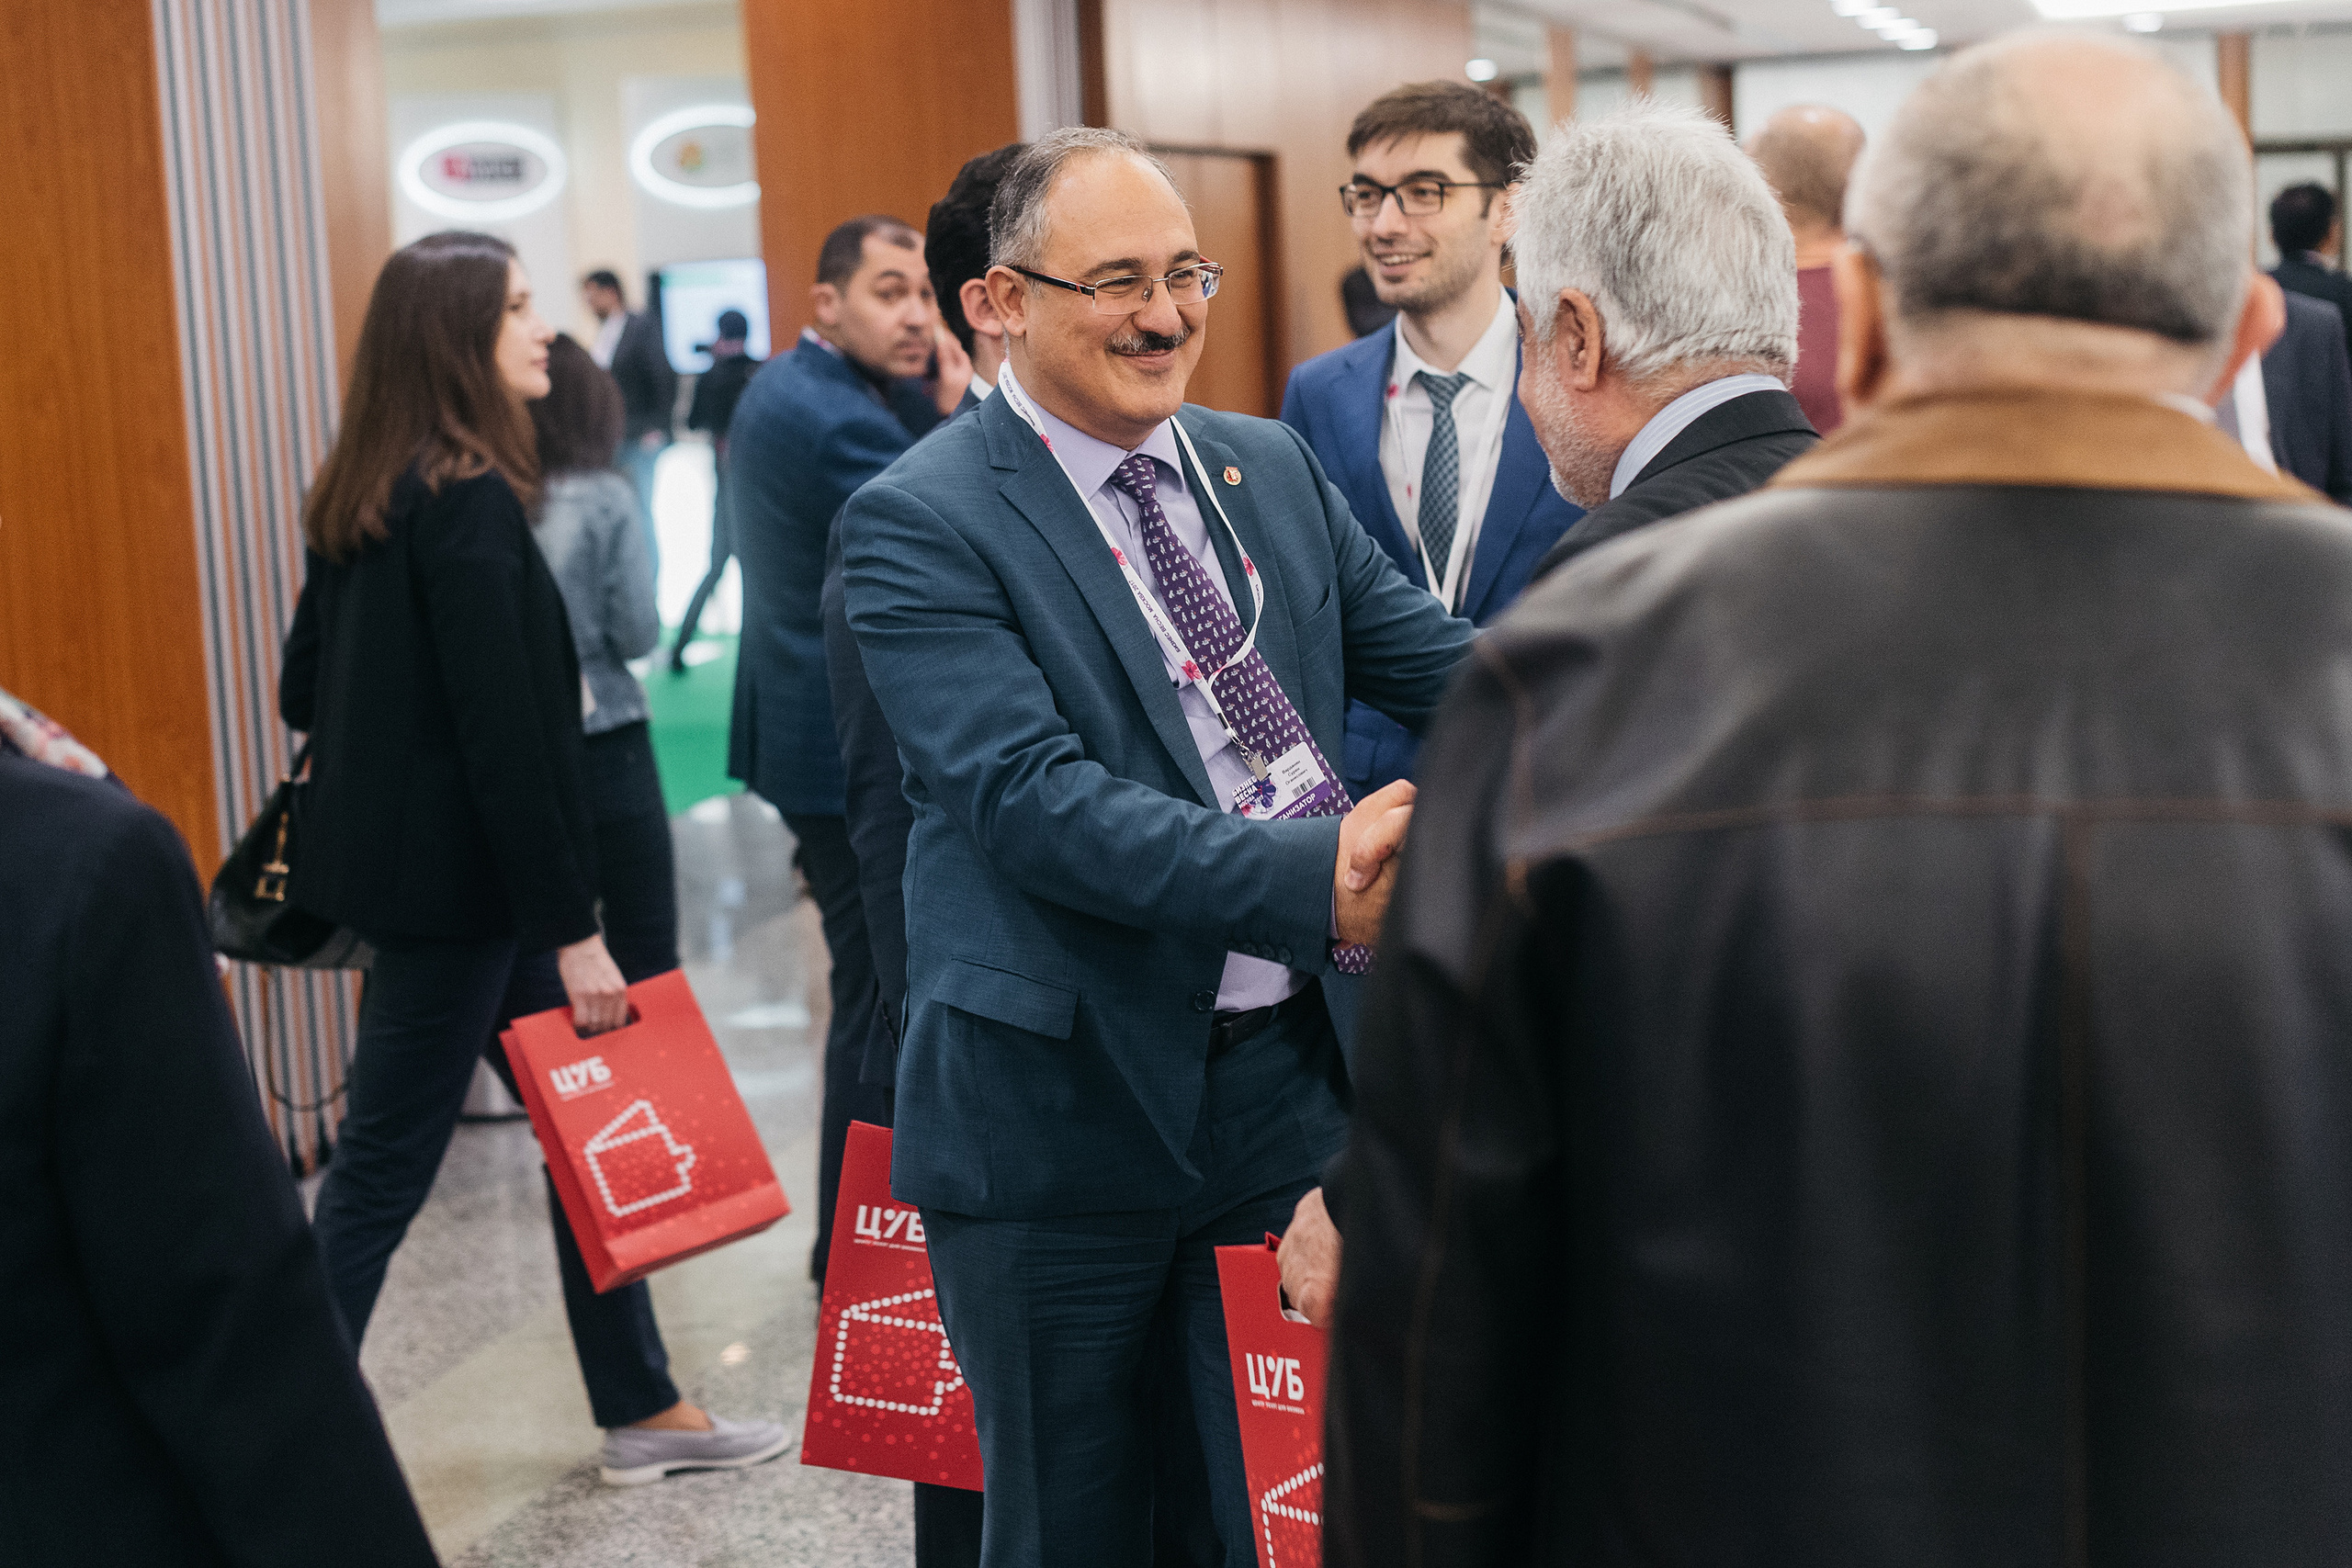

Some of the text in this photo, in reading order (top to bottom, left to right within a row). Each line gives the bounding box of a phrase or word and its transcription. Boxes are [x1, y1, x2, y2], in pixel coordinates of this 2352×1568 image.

[1136, 591, 1154, 613] МОСКВА
[1153, 614, 1167, 633] ВЕСНА
[1164, 632, 1181, 653] БИЗНЕС
[1235, 785, 1258, 803] ВЕСНА
[1277, 793, 1316, 820] ГАНИЗАТОР
[549, 1055, 612, 1094] ЦУБ
[1245, 1352, 1305, 1402] ЦУБ
